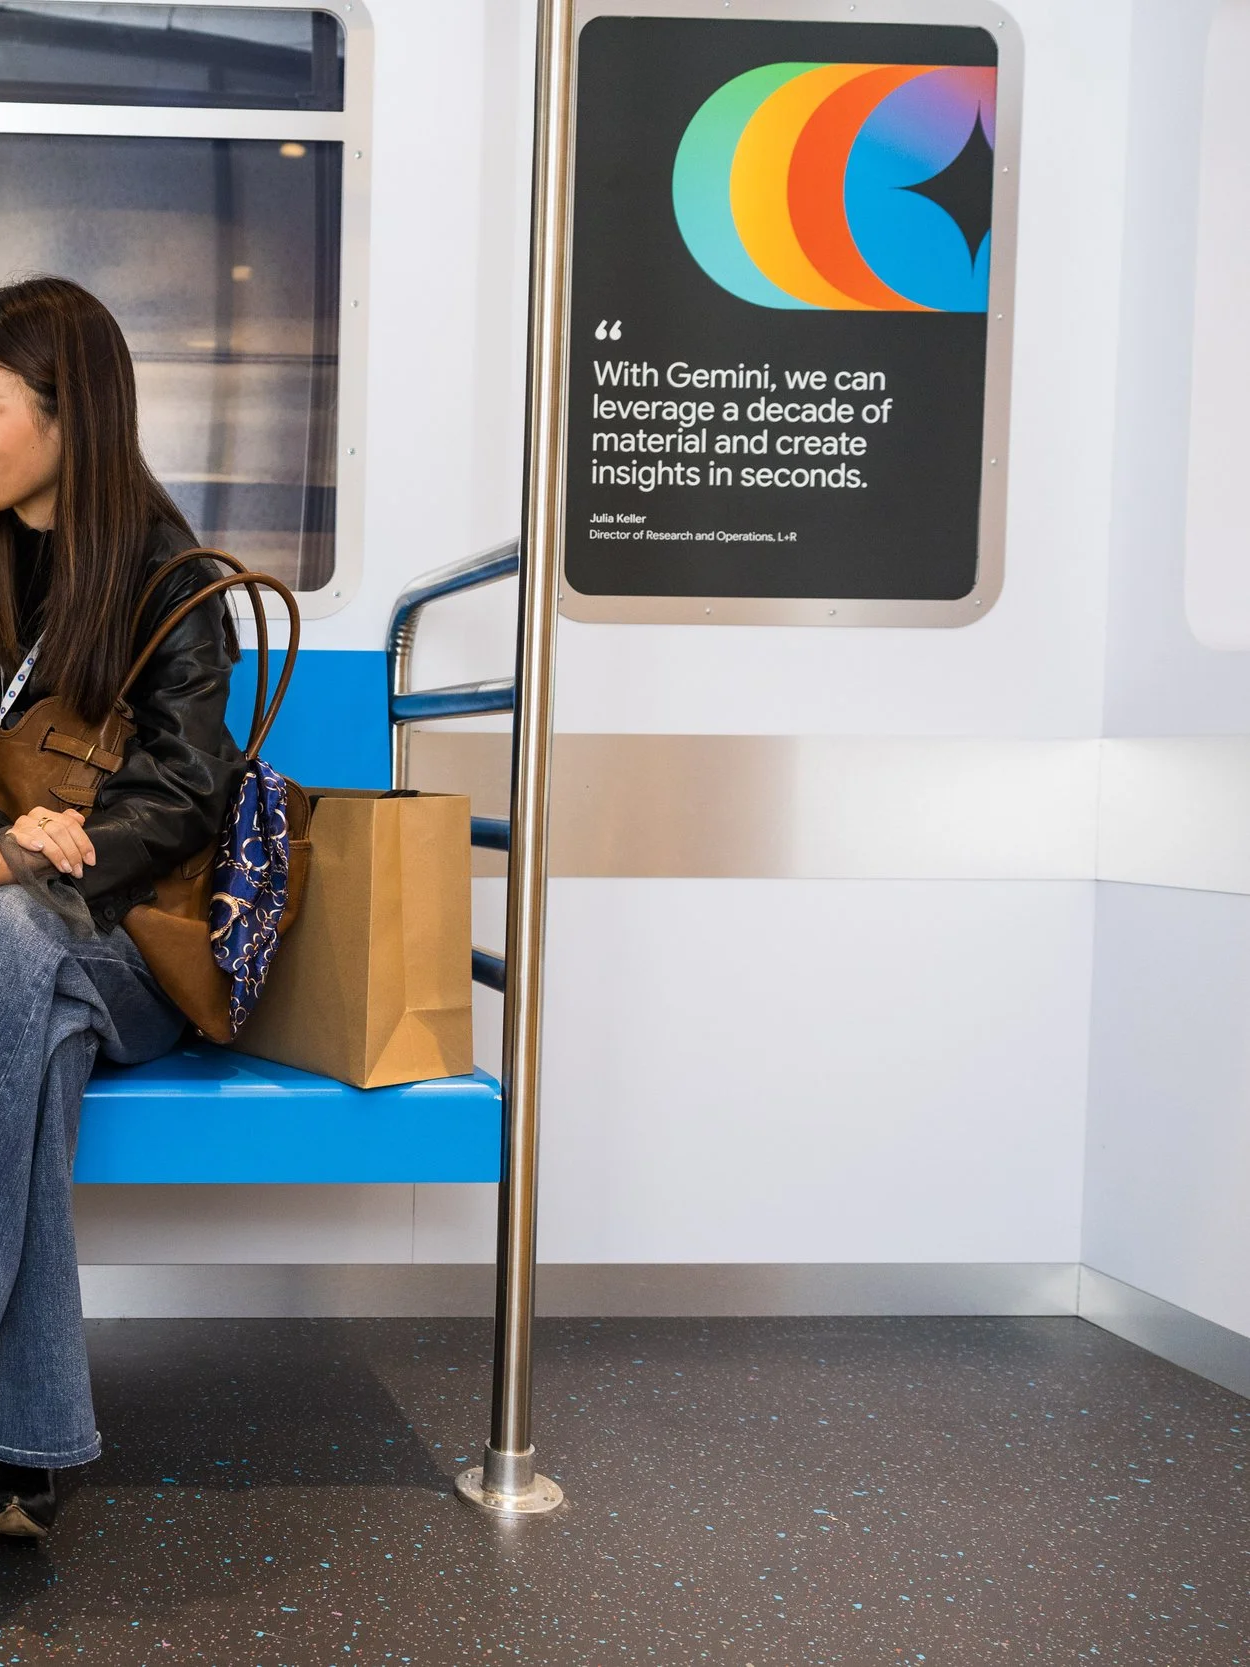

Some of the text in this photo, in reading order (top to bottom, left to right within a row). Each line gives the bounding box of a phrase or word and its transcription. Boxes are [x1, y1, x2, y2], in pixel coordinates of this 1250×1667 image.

[594, 361, 885, 392] With Gemini, we can
[593, 394, 893, 428] leverage a decade of
[593, 429, 867, 456] material and create
[592, 459, 867, 492] insights in seconds.
[590, 513, 646, 523] Julia Keller
[590, 529, 797, 543] Director of Research and Operations, L+R
